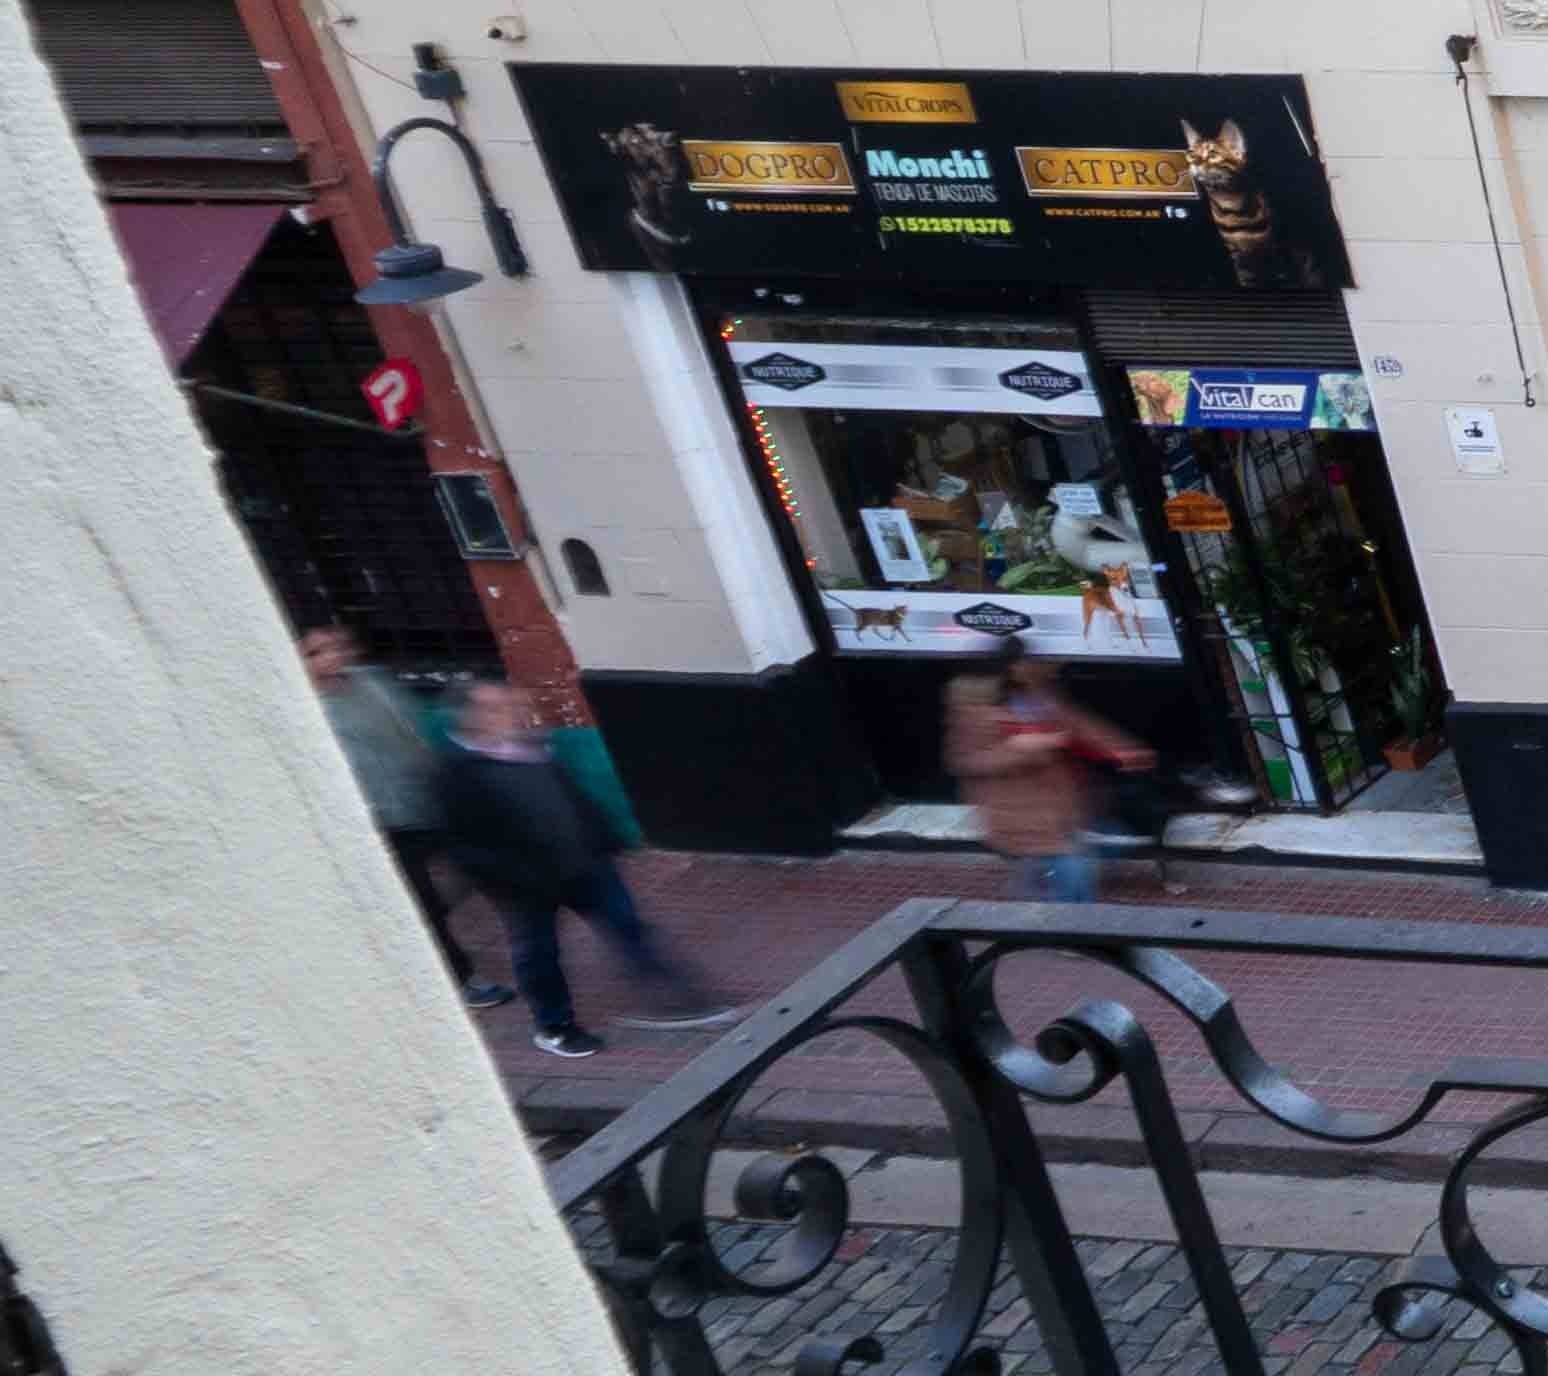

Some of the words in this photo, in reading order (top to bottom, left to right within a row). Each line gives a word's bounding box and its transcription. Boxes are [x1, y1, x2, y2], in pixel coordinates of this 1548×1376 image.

[692, 152, 838, 182] DOGPRO
[865, 148, 991, 179] Monchi
[1034, 158, 1183, 187] CATPRO
[873, 182, 915, 201] TIENDA
[917, 184, 933, 202] DE
[934, 184, 998, 203] MASCOTAS
[1008, 374, 1073, 389] NUTRIQUE
